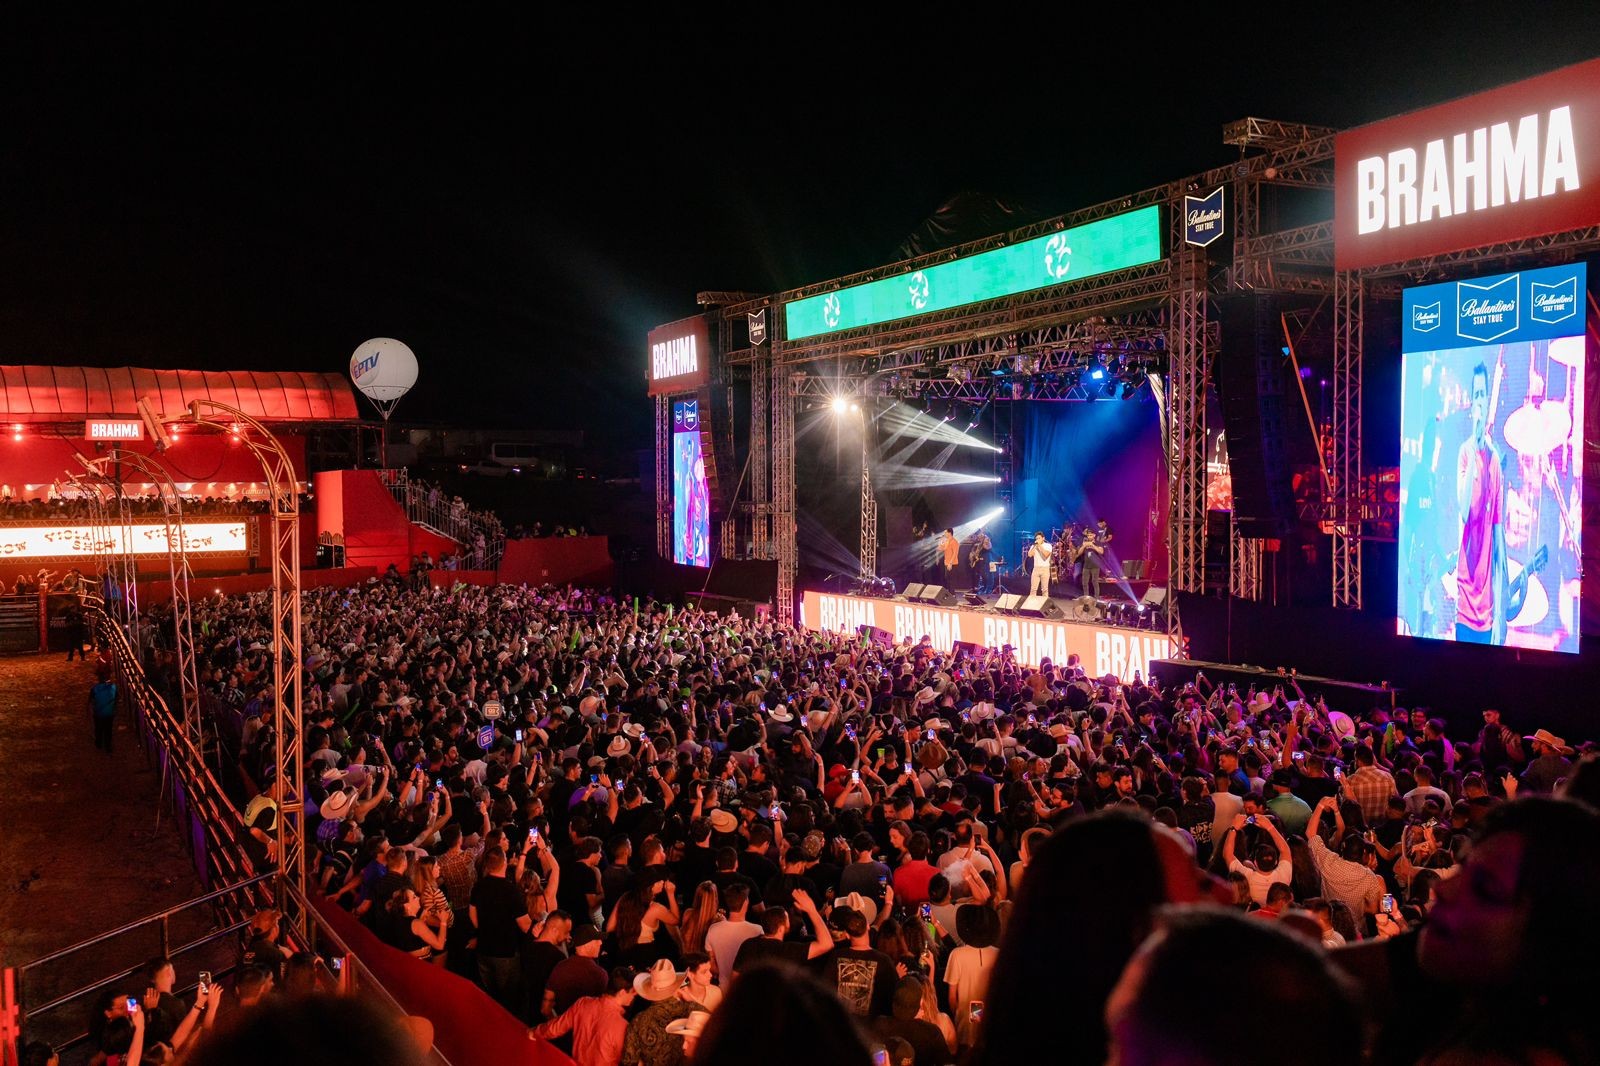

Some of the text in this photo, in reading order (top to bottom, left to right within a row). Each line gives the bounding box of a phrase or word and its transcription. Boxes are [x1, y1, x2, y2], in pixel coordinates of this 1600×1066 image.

[1357, 105, 1580, 236] BRAHMA
[1460, 299, 1516, 318] Ballantine's
[1533, 294, 1574, 307] Ballantine's
[1473, 314, 1503, 325] STAY TRUE
[354, 352, 380, 379] EPTV
[652, 334, 698, 380] BRAHMA
[91, 423, 139, 438] BRAHMA
[820, 596, 876, 635] BRAHMA
[895, 605, 962, 653] BRAHMA
[984, 617, 1067, 667] BRAHMA
